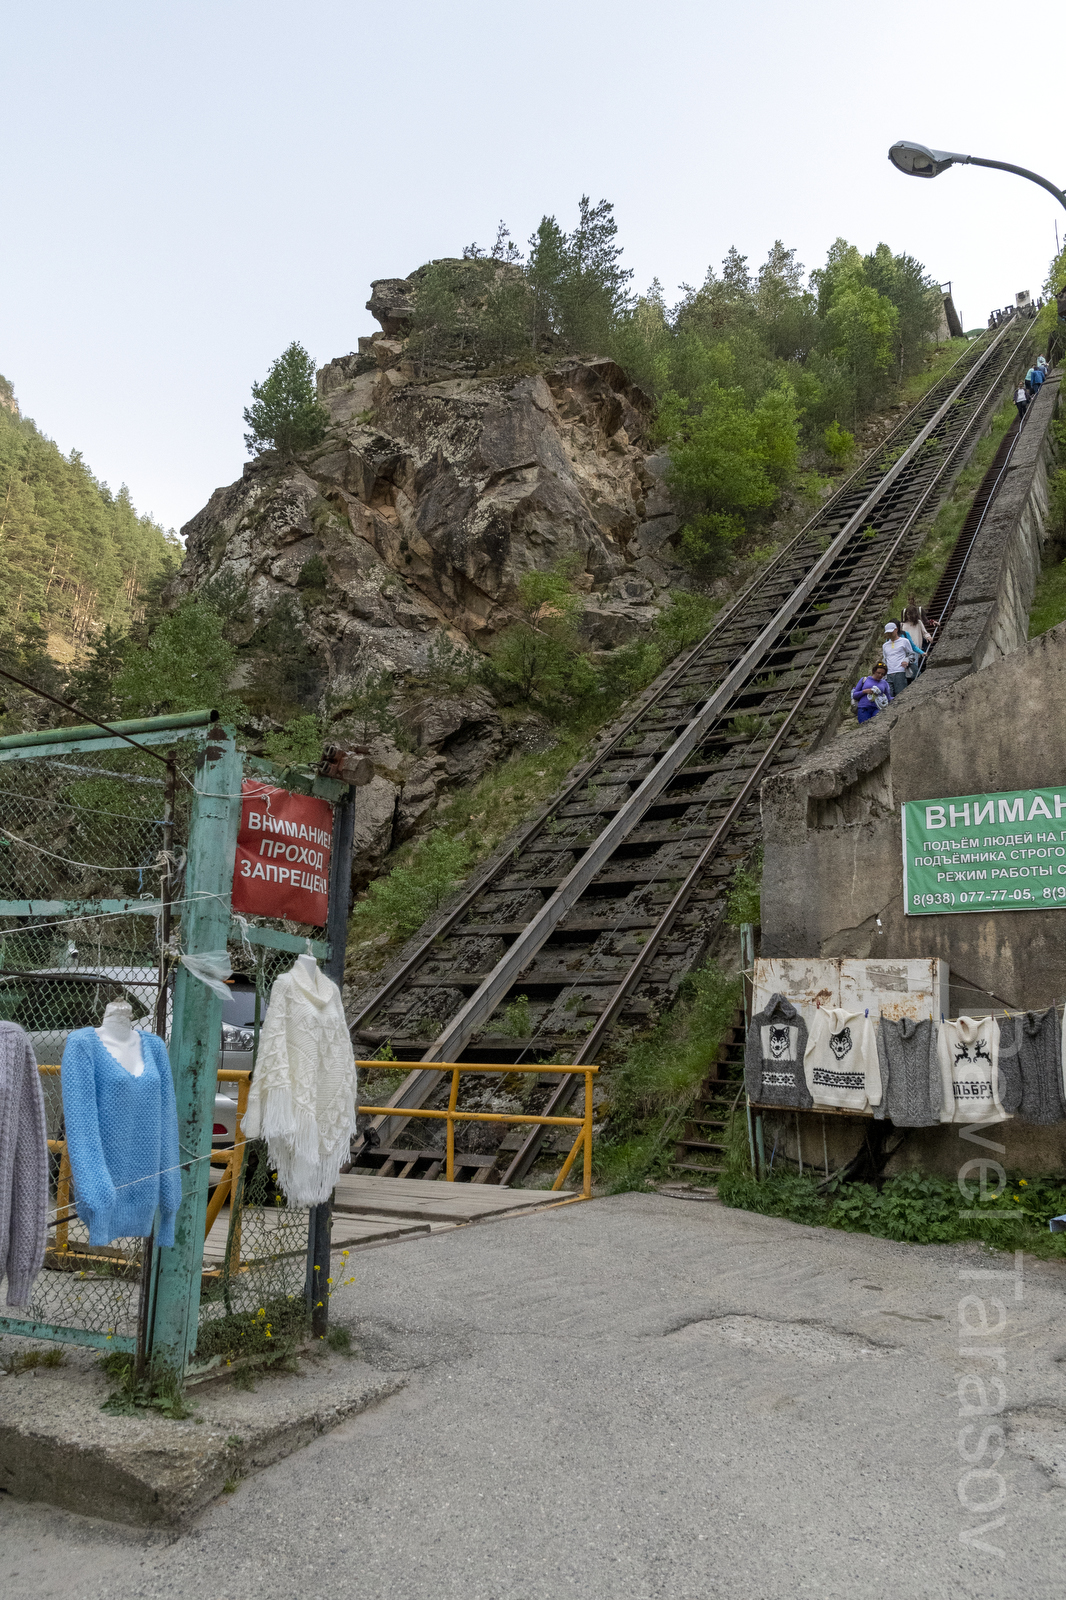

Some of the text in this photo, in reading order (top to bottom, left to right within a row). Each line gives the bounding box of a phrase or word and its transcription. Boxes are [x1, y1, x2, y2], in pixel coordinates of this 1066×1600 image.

[248, 811, 331, 849] ВНИМАНИЕ!
[923, 837, 979, 851] ПОДЪЁМ
[983, 832, 1033, 847] ЛЮДЕЙ
[1036, 832, 1057, 842] НА
[259, 839, 323, 872] ПРОХОД
[914, 847, 1065, 867] ПОДЪЁМНИКА СТРОГО
[240, 859, 327, 895] ЗАПРЕЩЕН!
[937, 870, 987, 882] РЕЖИМ
[991, 866, 1053, 879] РАБОТЫ
[913, 892, 955, 907] 8(938)
[959, 889, 1036, 903] 077-77-05,
